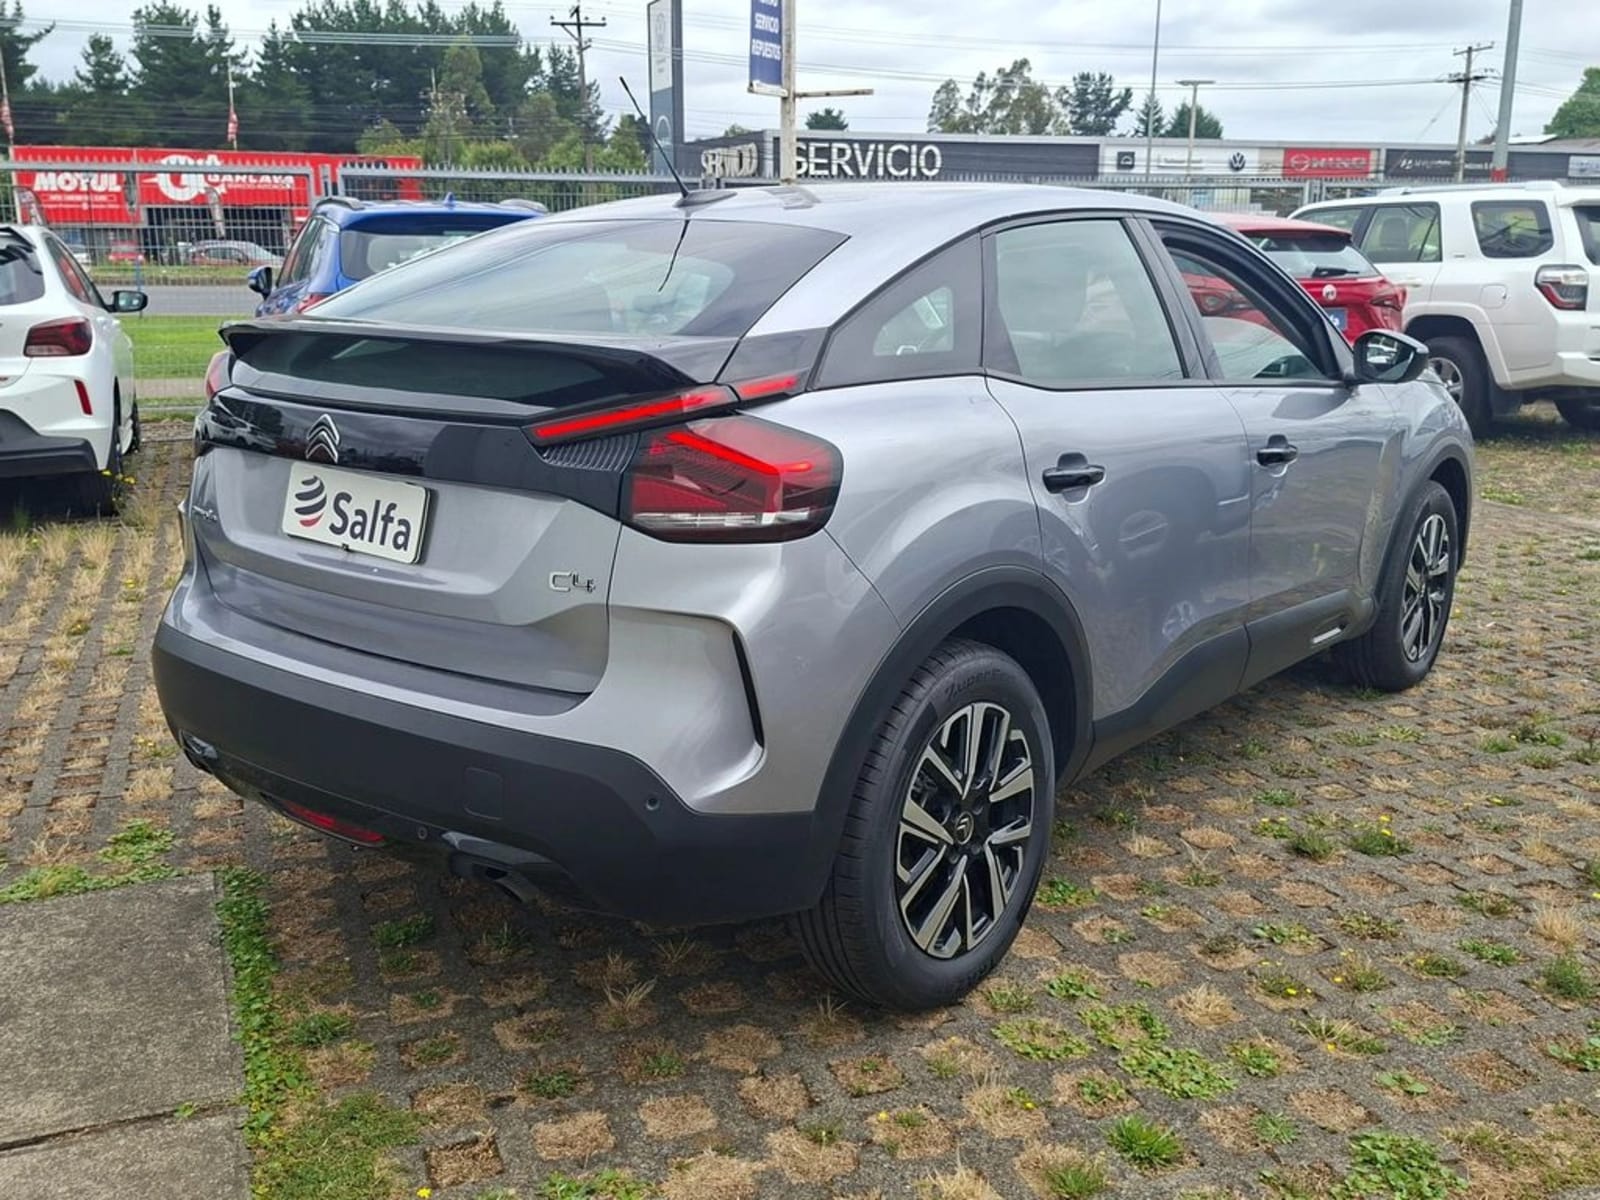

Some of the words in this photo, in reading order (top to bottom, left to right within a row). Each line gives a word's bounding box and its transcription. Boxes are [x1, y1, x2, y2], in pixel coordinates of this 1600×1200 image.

[795, 141, 943, 178] SERVICIO
[33, 171, 122, 192] MOTUL
[329, 490, 412, 552] Salfa
[549, 570, 596, 592] C4
